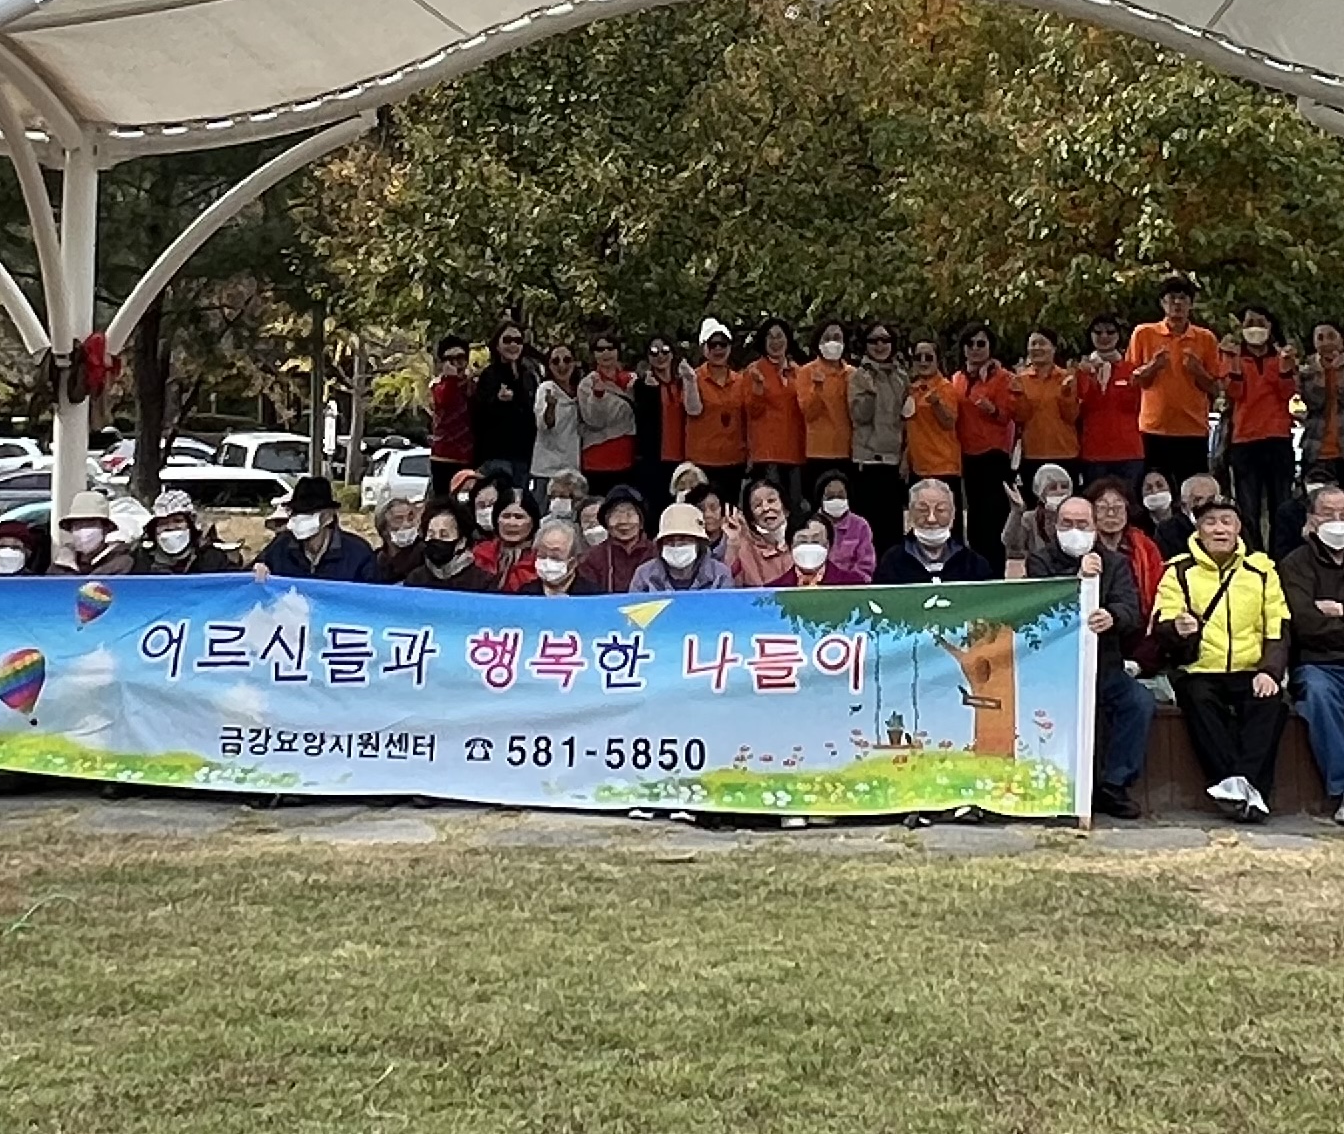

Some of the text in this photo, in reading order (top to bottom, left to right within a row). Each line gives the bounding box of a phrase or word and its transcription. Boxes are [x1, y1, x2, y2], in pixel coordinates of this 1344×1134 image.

[140, 622, 866, 691] 어르신들과 행복한 나들이
[219, 726, 706, 771] 금강요양지원센터 581-5850
